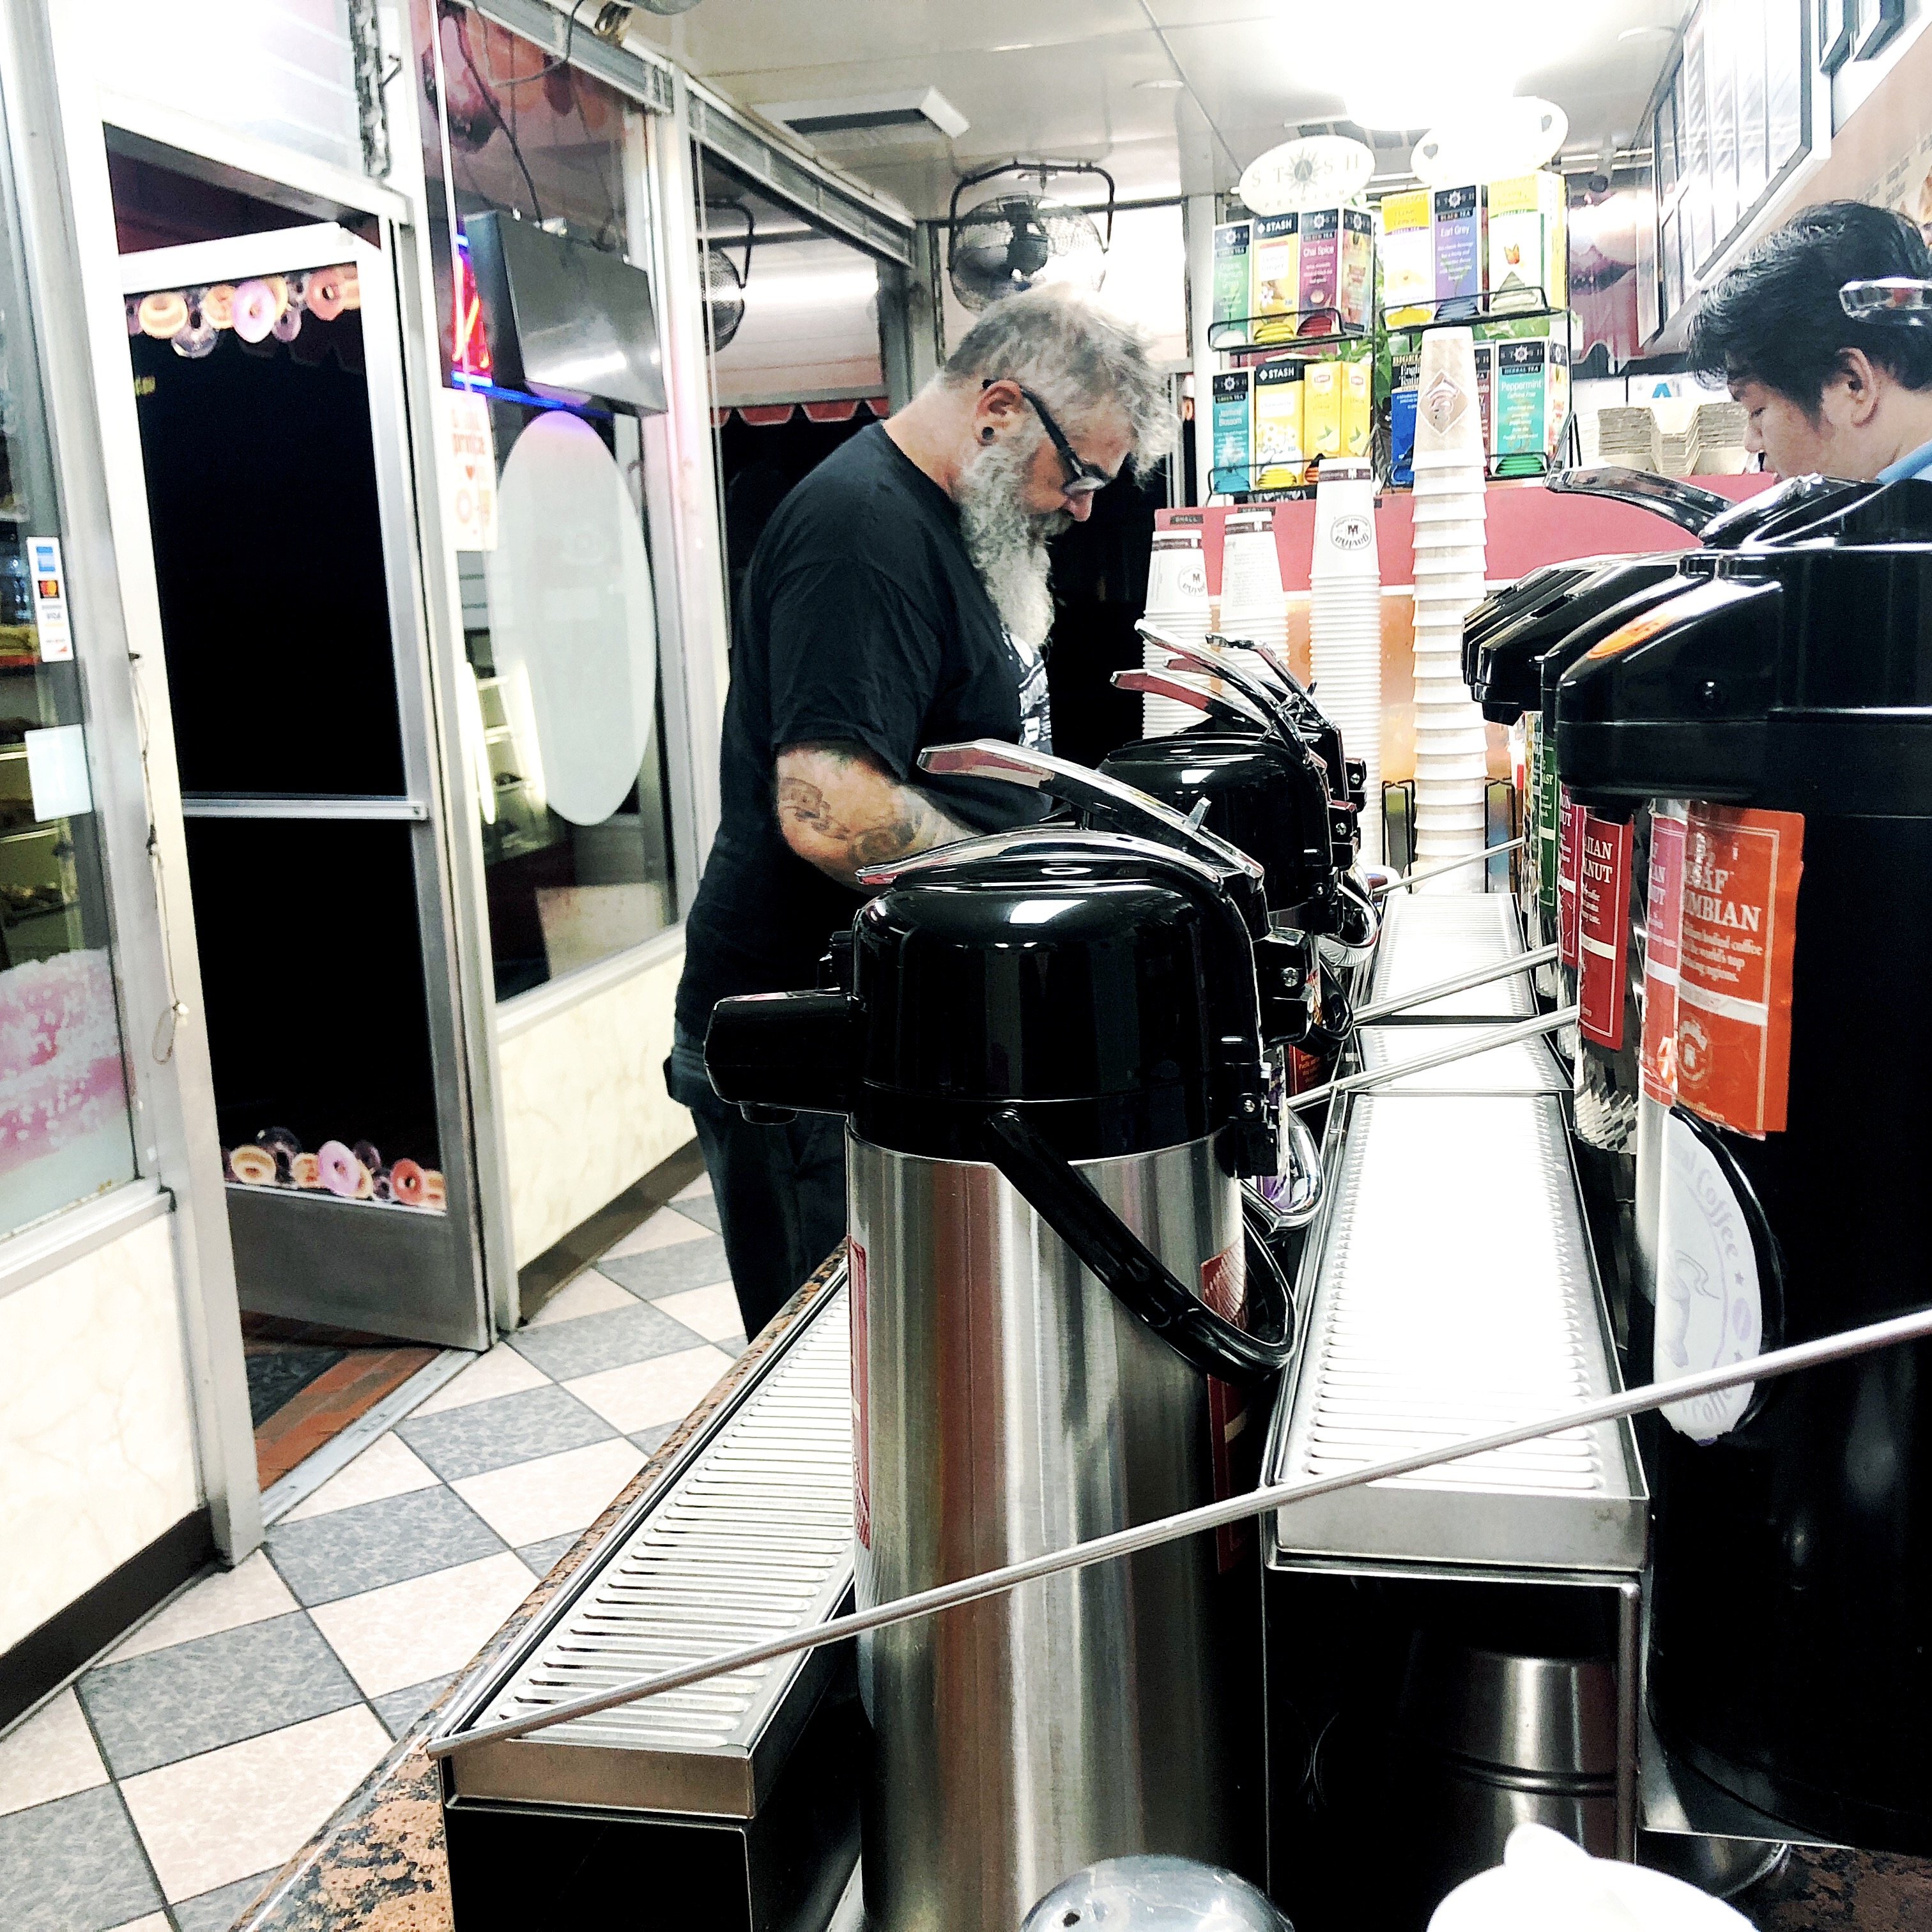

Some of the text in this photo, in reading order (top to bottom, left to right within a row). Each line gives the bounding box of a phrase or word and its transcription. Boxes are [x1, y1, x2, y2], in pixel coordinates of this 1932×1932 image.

[1266, 220, 1292, 233] STASH
[1440, 225, 1470, 237] Earl Grey
[1303, 245, 1335, 258] Chai Spice
[1268, 367, 1295, 379] STASH
[1400, 364, 1420, 376] Engli
[1501, 379, 1542, 392] Peppermint
[1696, 1167, 1739, 1260] Coffee
